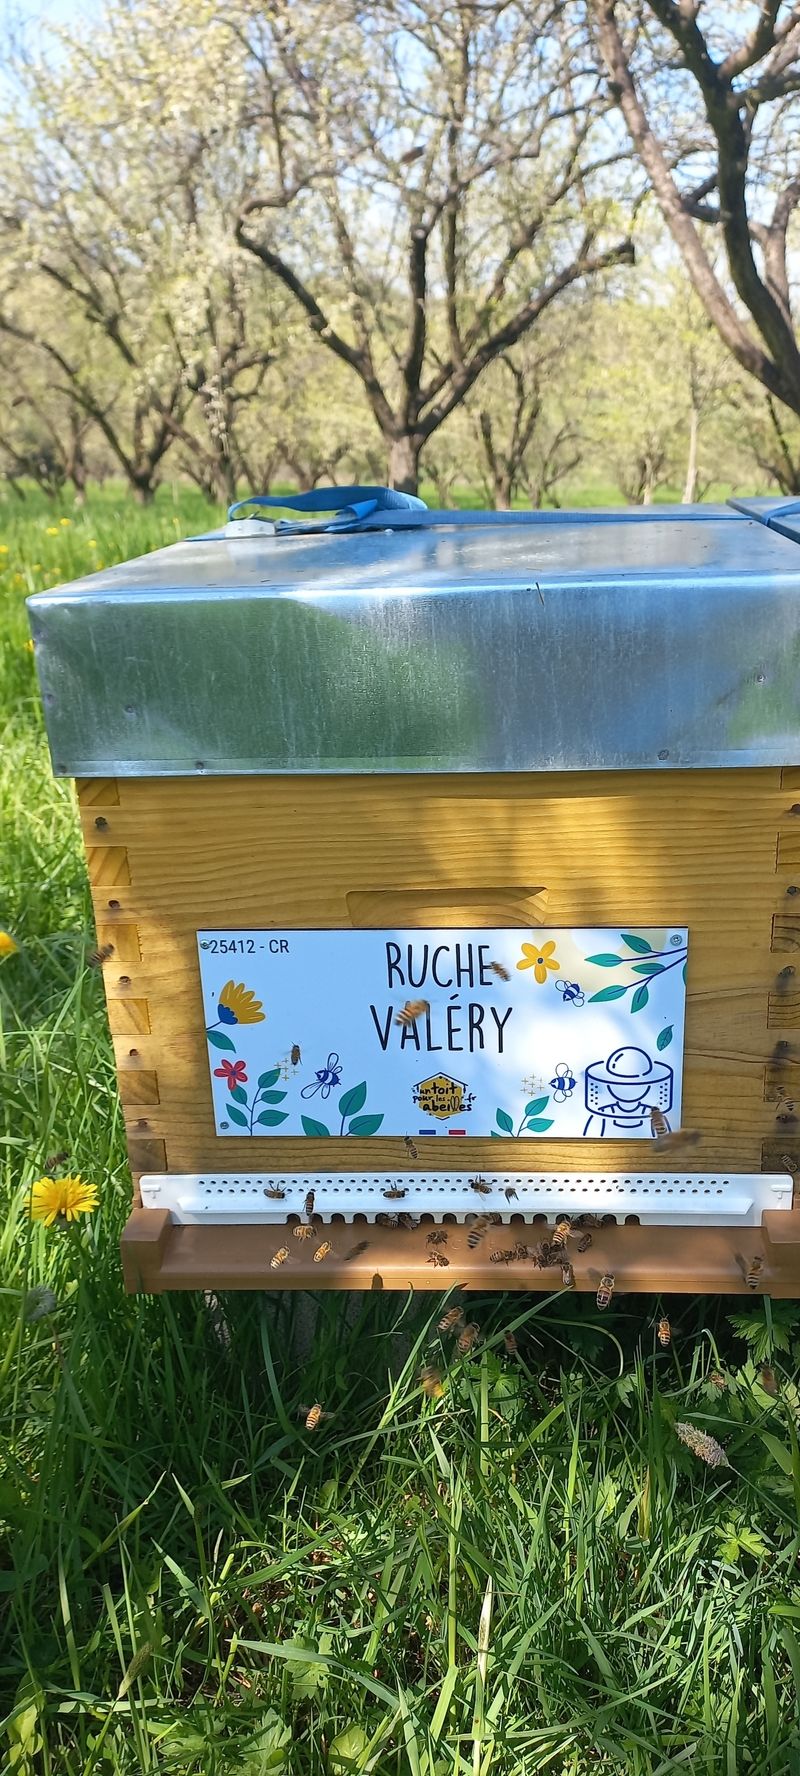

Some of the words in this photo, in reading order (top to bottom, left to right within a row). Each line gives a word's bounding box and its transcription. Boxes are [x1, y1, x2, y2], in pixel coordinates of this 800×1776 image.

[209, 940, 256, 954] 25412
[269, 939, 290, 954] CR
[386, 942, 494, 988] RUCHE
[370, 993, 513, 1054] VALÉRY
[431, 1082, 457, 1095] toit
[412, 1095, 433, 1104] pour
[422, 1095, 473, 1112] abeilles
